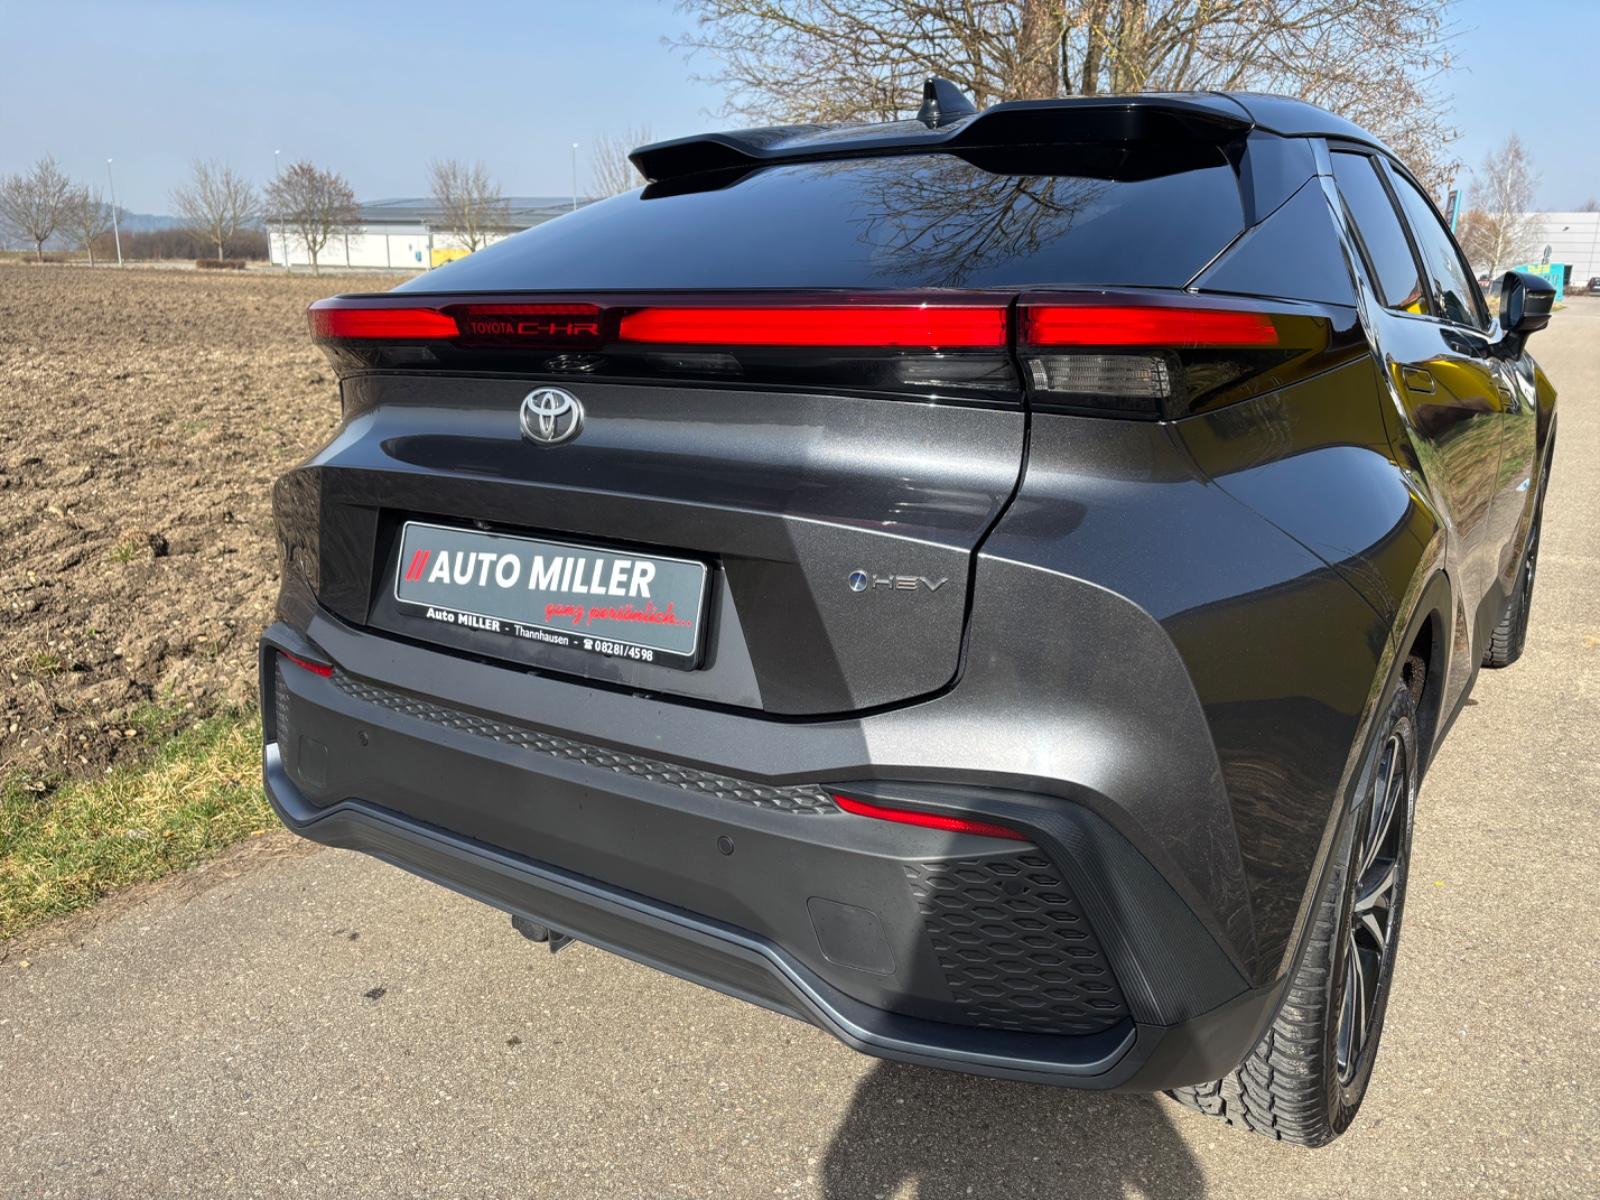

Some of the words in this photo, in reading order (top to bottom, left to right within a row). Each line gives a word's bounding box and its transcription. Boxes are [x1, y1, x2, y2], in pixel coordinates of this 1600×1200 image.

[471, 322, 514, 334] TOYOTA
[517, 322, 599, 335] C-HR
[428, 550, 521, 588] AUTO
[528, 555, 656, 598] MILLER
[872, 574, 949, 591] HEV
[426, 607, 455, 622] Auto
[458, 614, 500, 632] MILLER
[514, 625, 569, 646] Thannhausen
